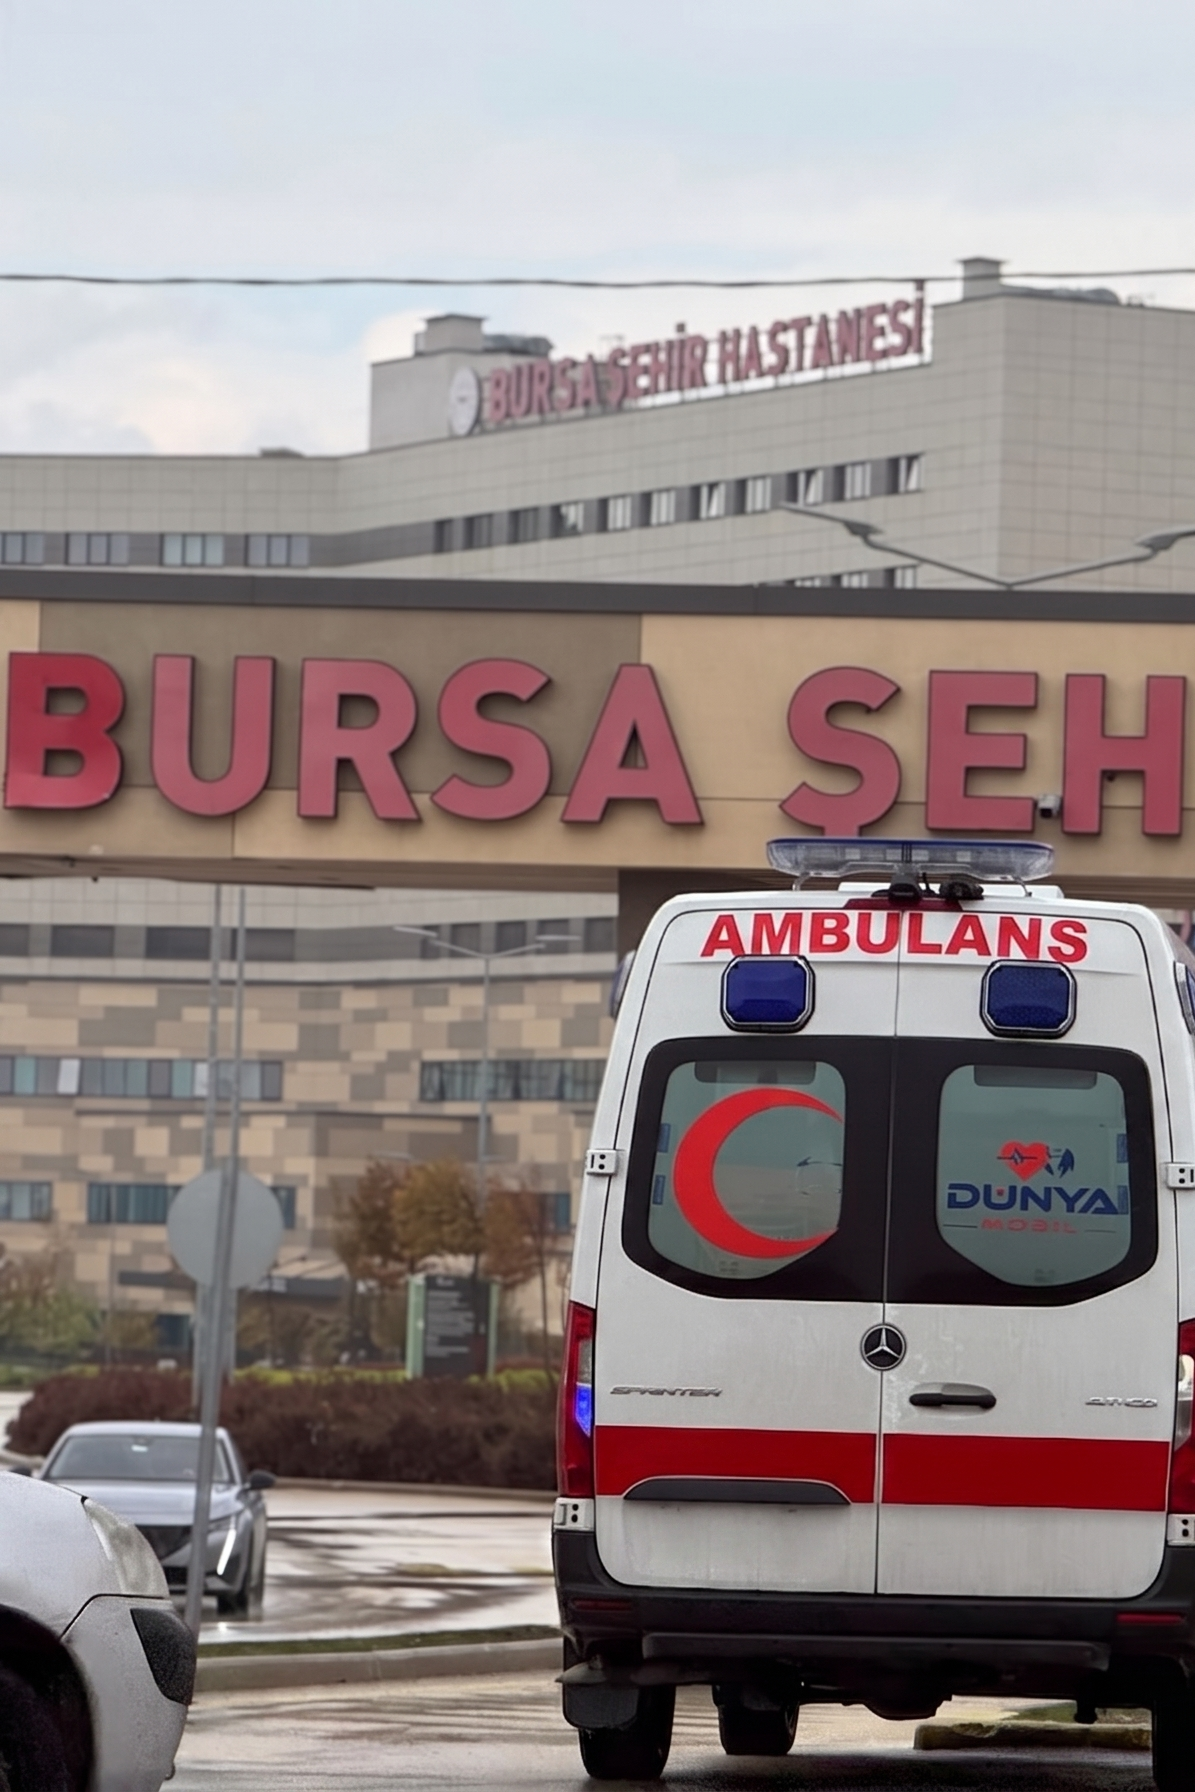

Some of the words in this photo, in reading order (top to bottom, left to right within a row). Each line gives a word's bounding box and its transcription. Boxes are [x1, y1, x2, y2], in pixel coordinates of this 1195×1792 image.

[488, 353, 601, 422] BURSA
[717, 279, 924, 385] HASTANESİ
[4, 650, 706, 826] BURSA
[699, 911, 1090, 963] AMBULANS
